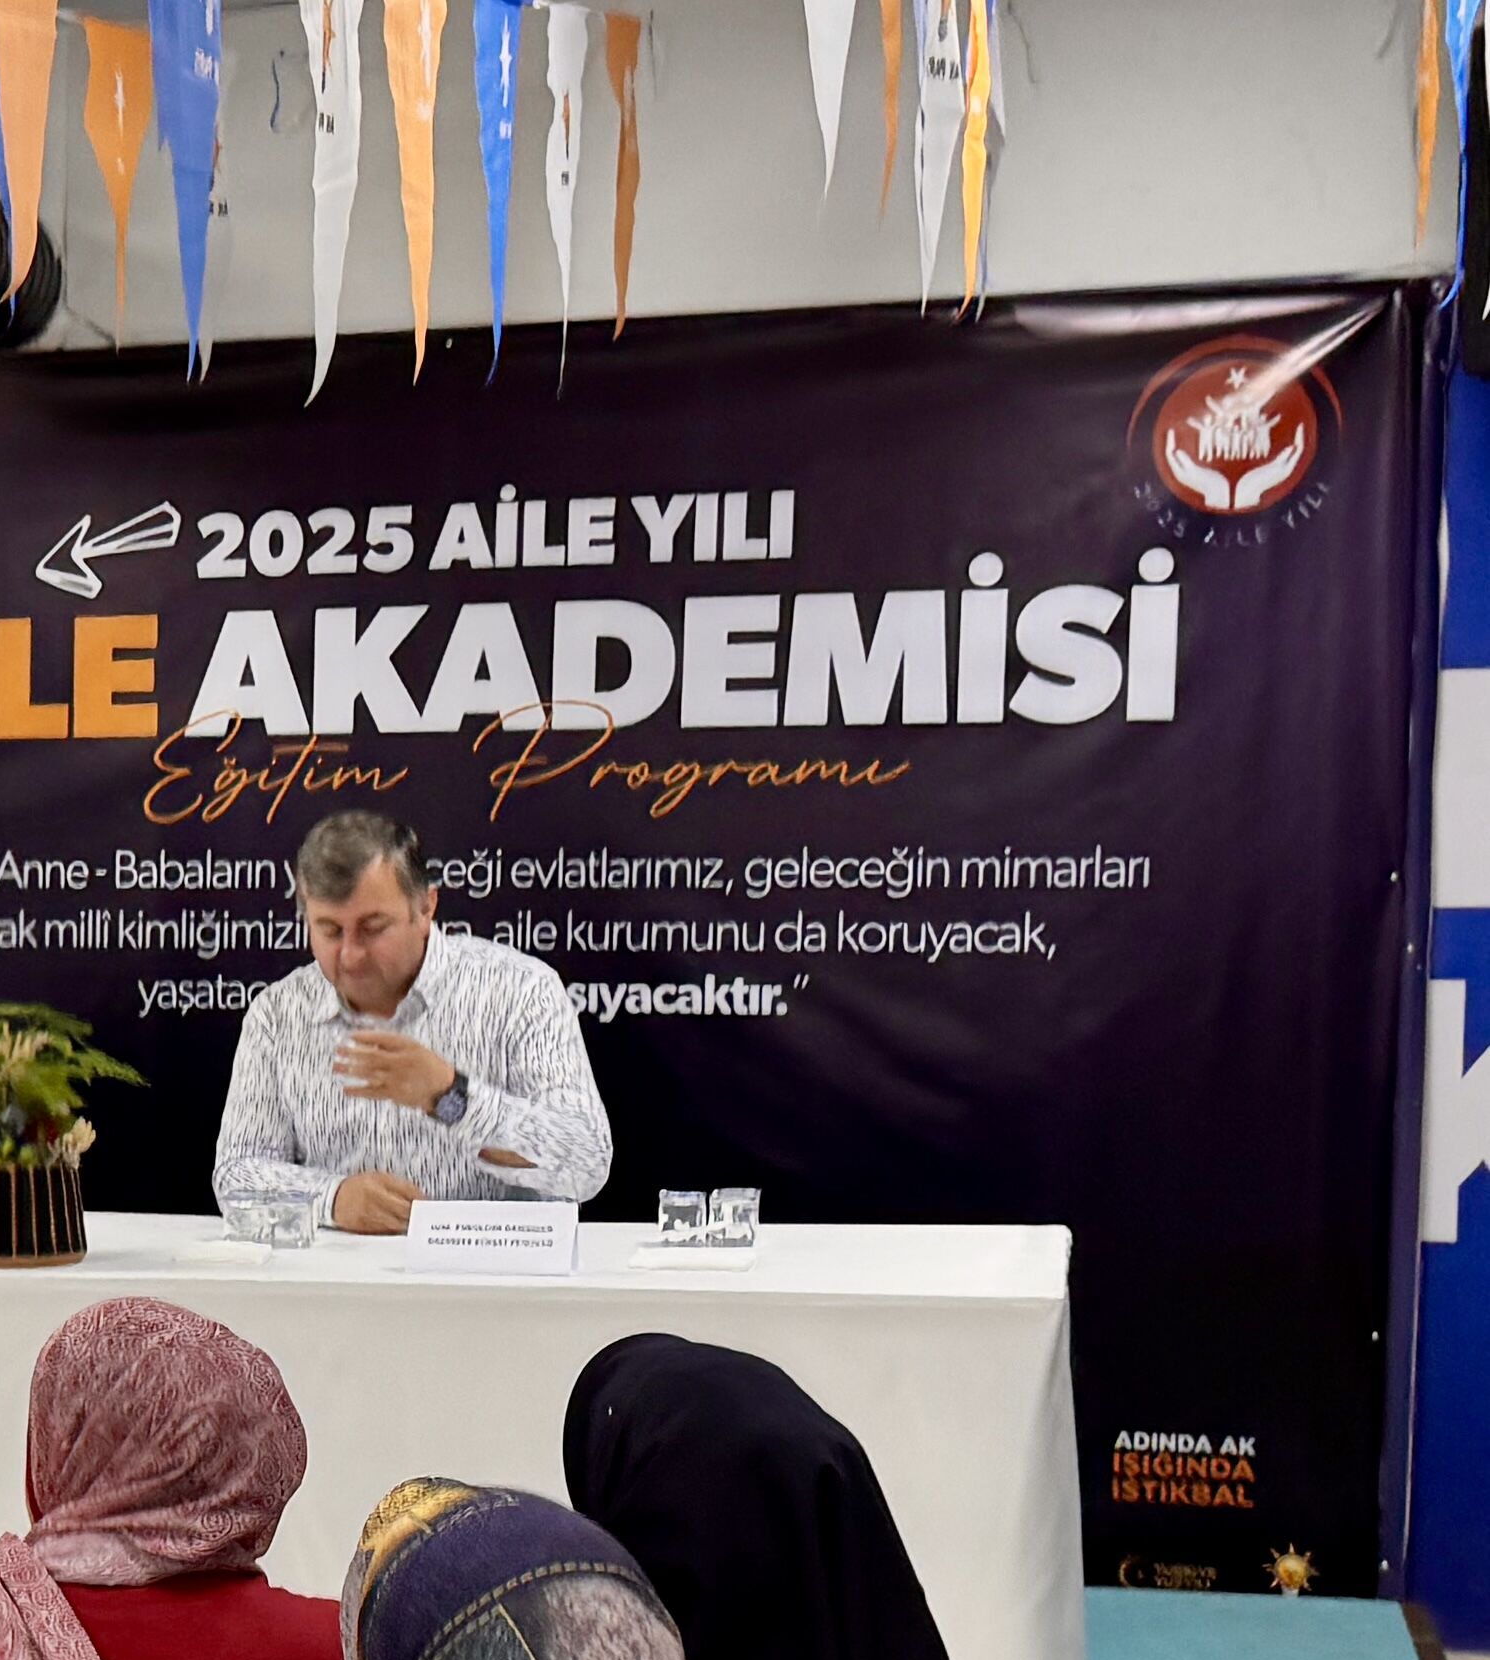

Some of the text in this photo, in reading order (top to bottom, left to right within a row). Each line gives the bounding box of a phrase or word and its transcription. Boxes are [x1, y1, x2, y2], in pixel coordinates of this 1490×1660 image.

[196, 483, 795, 579] 2025 AİLE YILI
[183, 546, 1181, 738] AKADEMİSİ
[143, 699, 912, 825] Eğitim Programı
[115, 848, 276, 890] Babaların
[510, 847, 734, 896] evlatlarımız,
[744, 845, 950, 899] geleceğin
[961, 844, 1151, 890] mimarları
[493, 909, 1057, 963] aile kurumunu da koruyacak,
[1114, 1429, 1256, 1457] ADINDA AK
